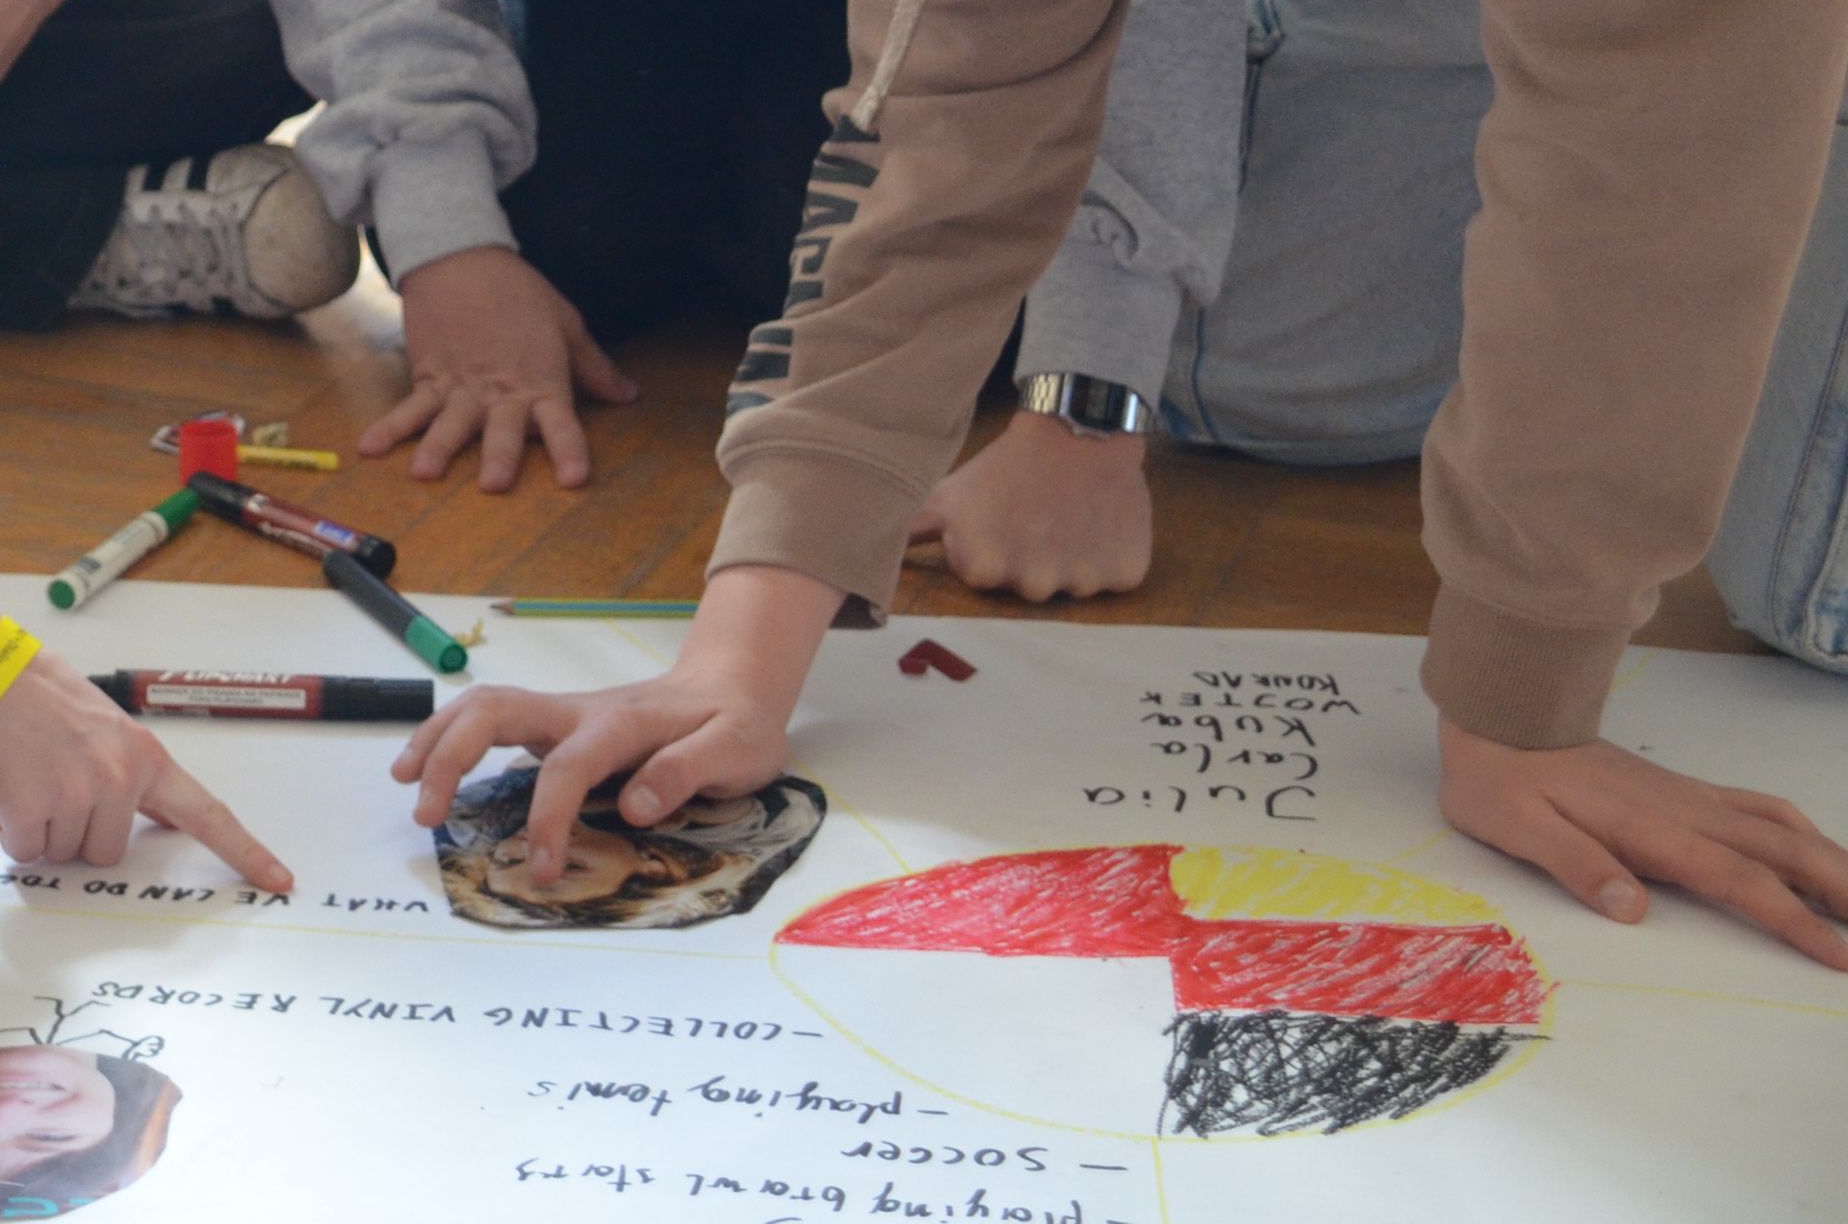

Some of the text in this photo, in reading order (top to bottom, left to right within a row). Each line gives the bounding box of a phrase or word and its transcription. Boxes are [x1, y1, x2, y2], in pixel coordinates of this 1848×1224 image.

[1140, 691, 1360, 719] WOJTEK
[1141, 713, 1316, 748] Kuba
[1152, 741, 1318, 780] Carla
[1083, 785, 1316, 822] Julia
[83, 880, 129, 897] DO
[137, 885, 216, 903] CAN
[321, 892, 430, 914] WHAT
[90, 982, 298, 1014] RECORDS
[319, 996, 457, 1024] VINYL
[687, 1074, 903, 1125] playing
[515, 1157, 654, 1193] stars
[685, 1173, 847, 1213] brawl
